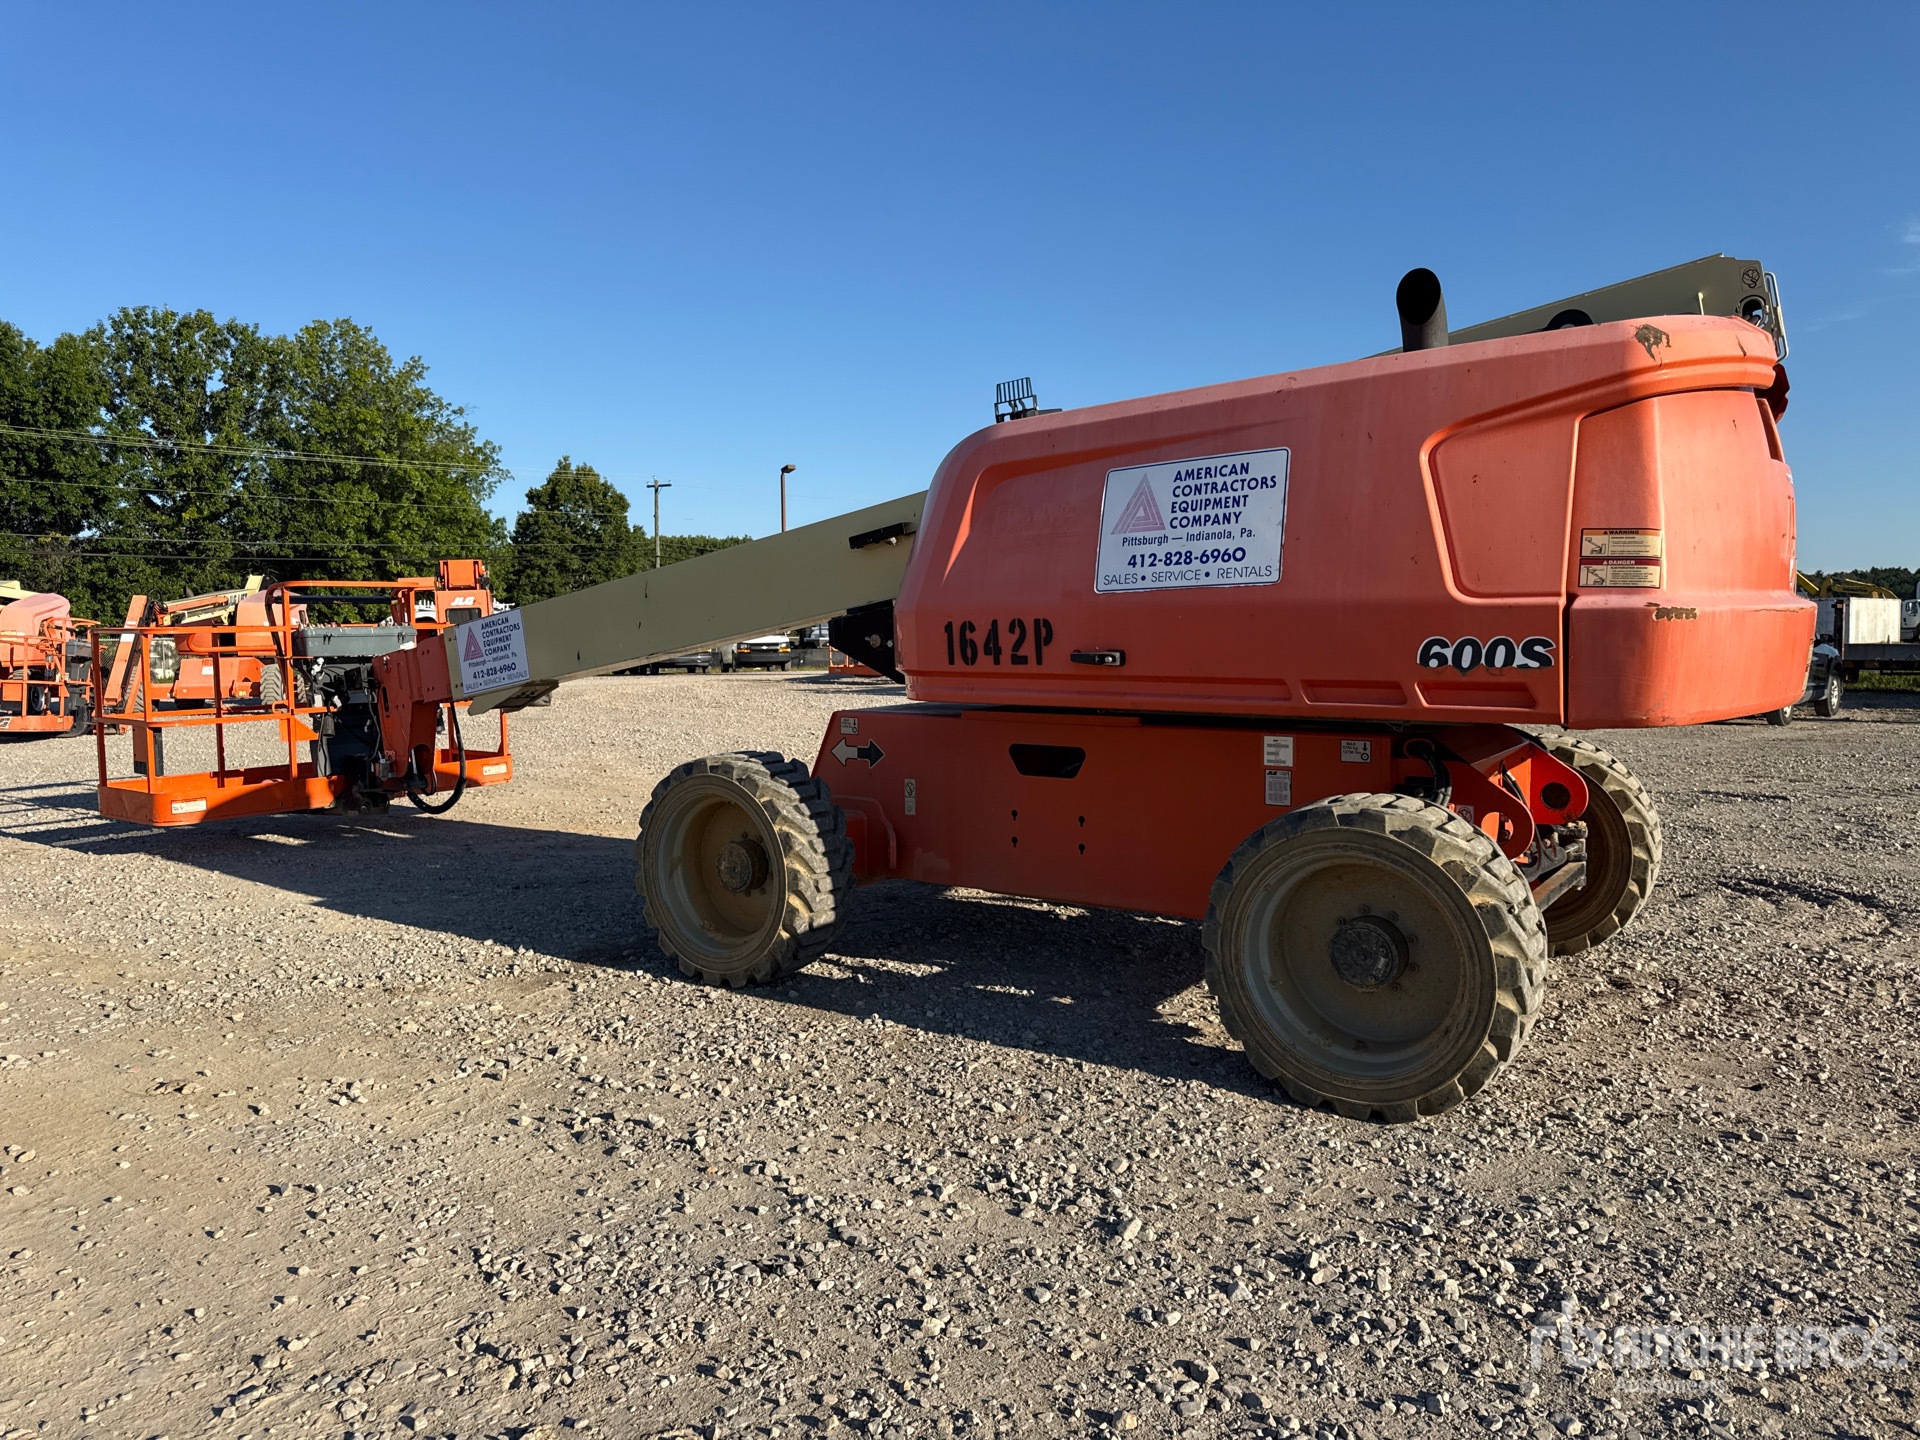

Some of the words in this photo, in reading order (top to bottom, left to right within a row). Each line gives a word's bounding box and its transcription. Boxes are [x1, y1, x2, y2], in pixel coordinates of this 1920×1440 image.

[1173, 461, 1250, 483] AMERICAN
[1172, 475, 1278, 498] CONTRACTORS
[1170, 494, 1250, 514] EQUIPMENT
[1169, 511, 1243, 530] COMPANY
[1121, 533, 1169, 547] Pittsburgh
[1186, 528, 1235, 543] Indianola,
[1240, 527, 1256, 539] Pa.
[1127, 546, 1247, 569] 412-828-6960
[1103, 572, 1139, 586] SALES
[1150, 569, 1202, 583] SERVICE
[1216, 565, 1273, 580] RENTALS
[450, 596, 476, 606] JLG
[480, 616, 508, 630] AMERICAN
[482, 623, 520, 638] CONTRACTORS
[483, 634, 512, 648] EQUIPMENT
[484, 643, 511, 657] COMPANY
[944, 617, 1054, 666] 1642P
[1416, 635, 1557, 672] 600S
[468, 660, 487, 668] Pittsburgh
[472, 662, 517, 680] 412-828-6960
[465, 682, 480, 690] SALES
[483, 677, 502, 686] SERVICE
[507, 671, 527, 680] RENTALS
